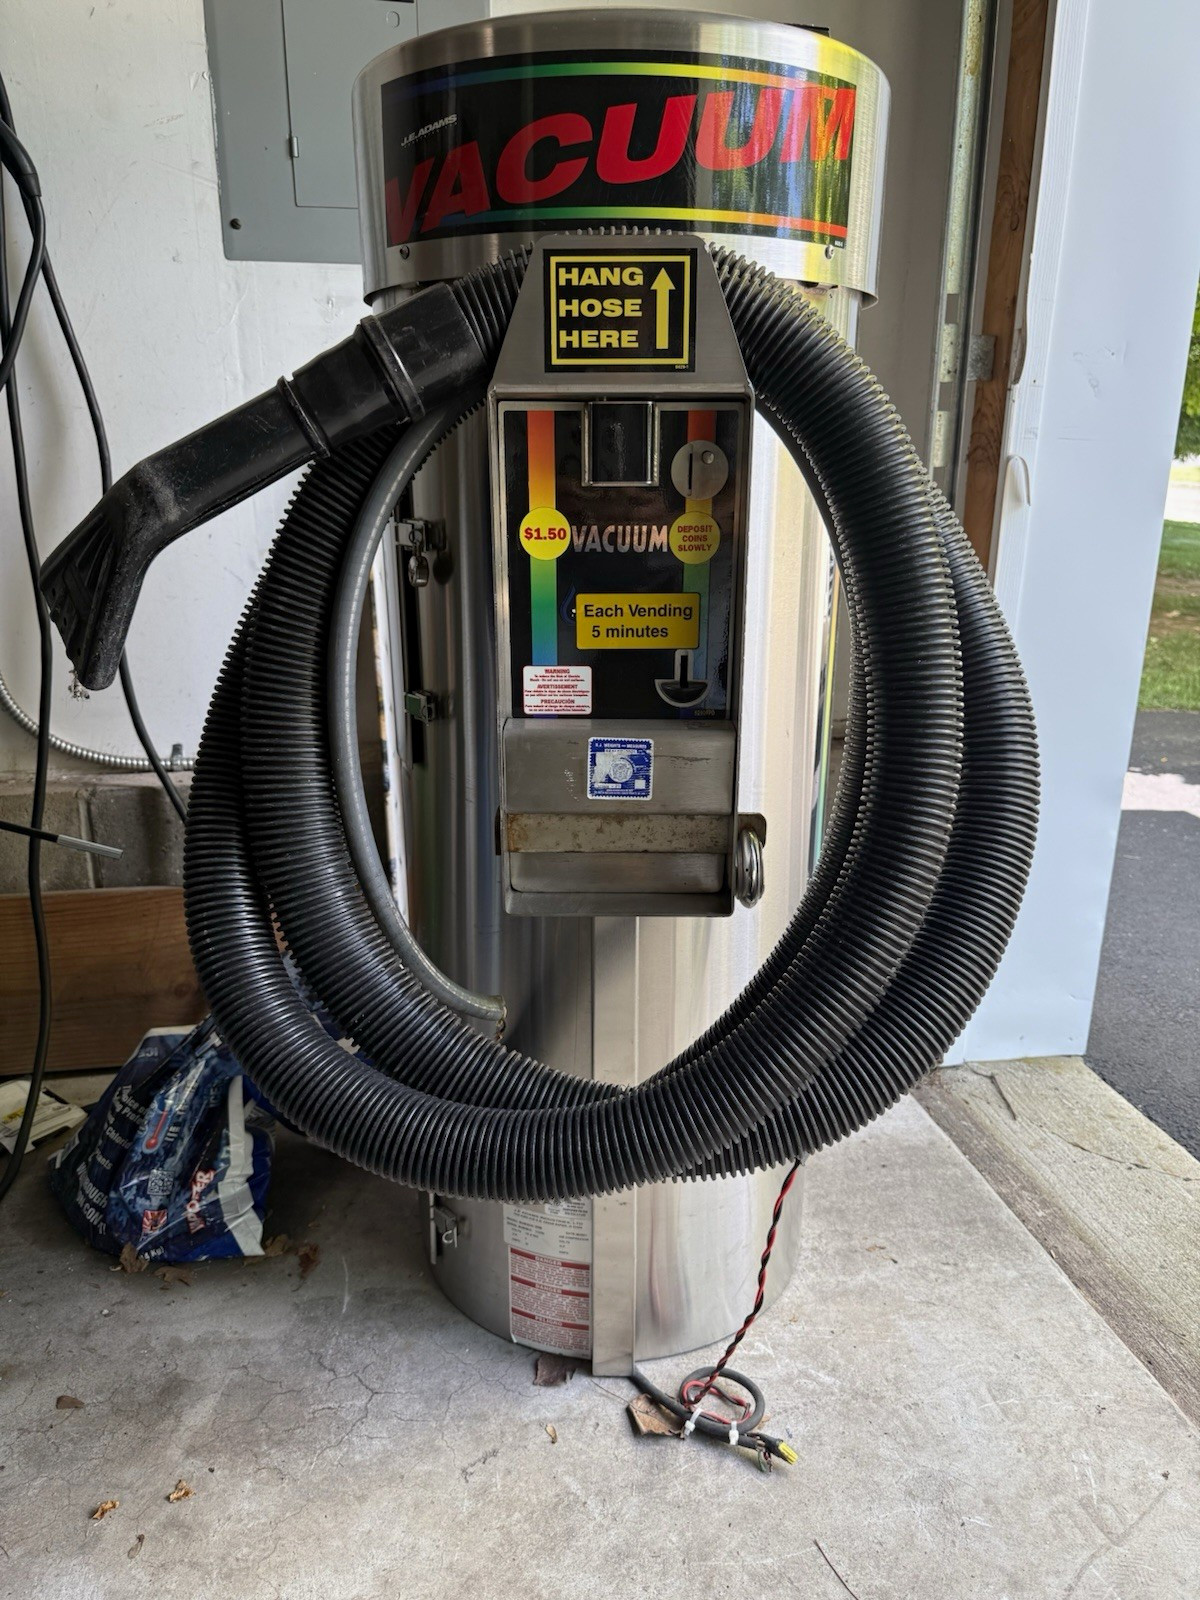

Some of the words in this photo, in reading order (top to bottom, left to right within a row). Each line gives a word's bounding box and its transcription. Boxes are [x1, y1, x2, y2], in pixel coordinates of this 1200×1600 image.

[385, 86, 857, 245] VACUUM
[558, 267, 644, 286] HANG
[558, 298, 643, 318] HOSE
[558, 329, 639, 349] HERE
[524, 527, 567, 540] $1.50
[677, 525, 713, 534] DEPOSIT
[570, 524, 669, 553] VACUUM
[682, 534, 708, 543] COINS
[677, 543, 712, 552] SLOWLY
[583, 604, 624, 618] Each
[627, 604, 693, 620] Vending
[591, 625, 601, 638] 5
[605, 624, 669, 638] minutes
